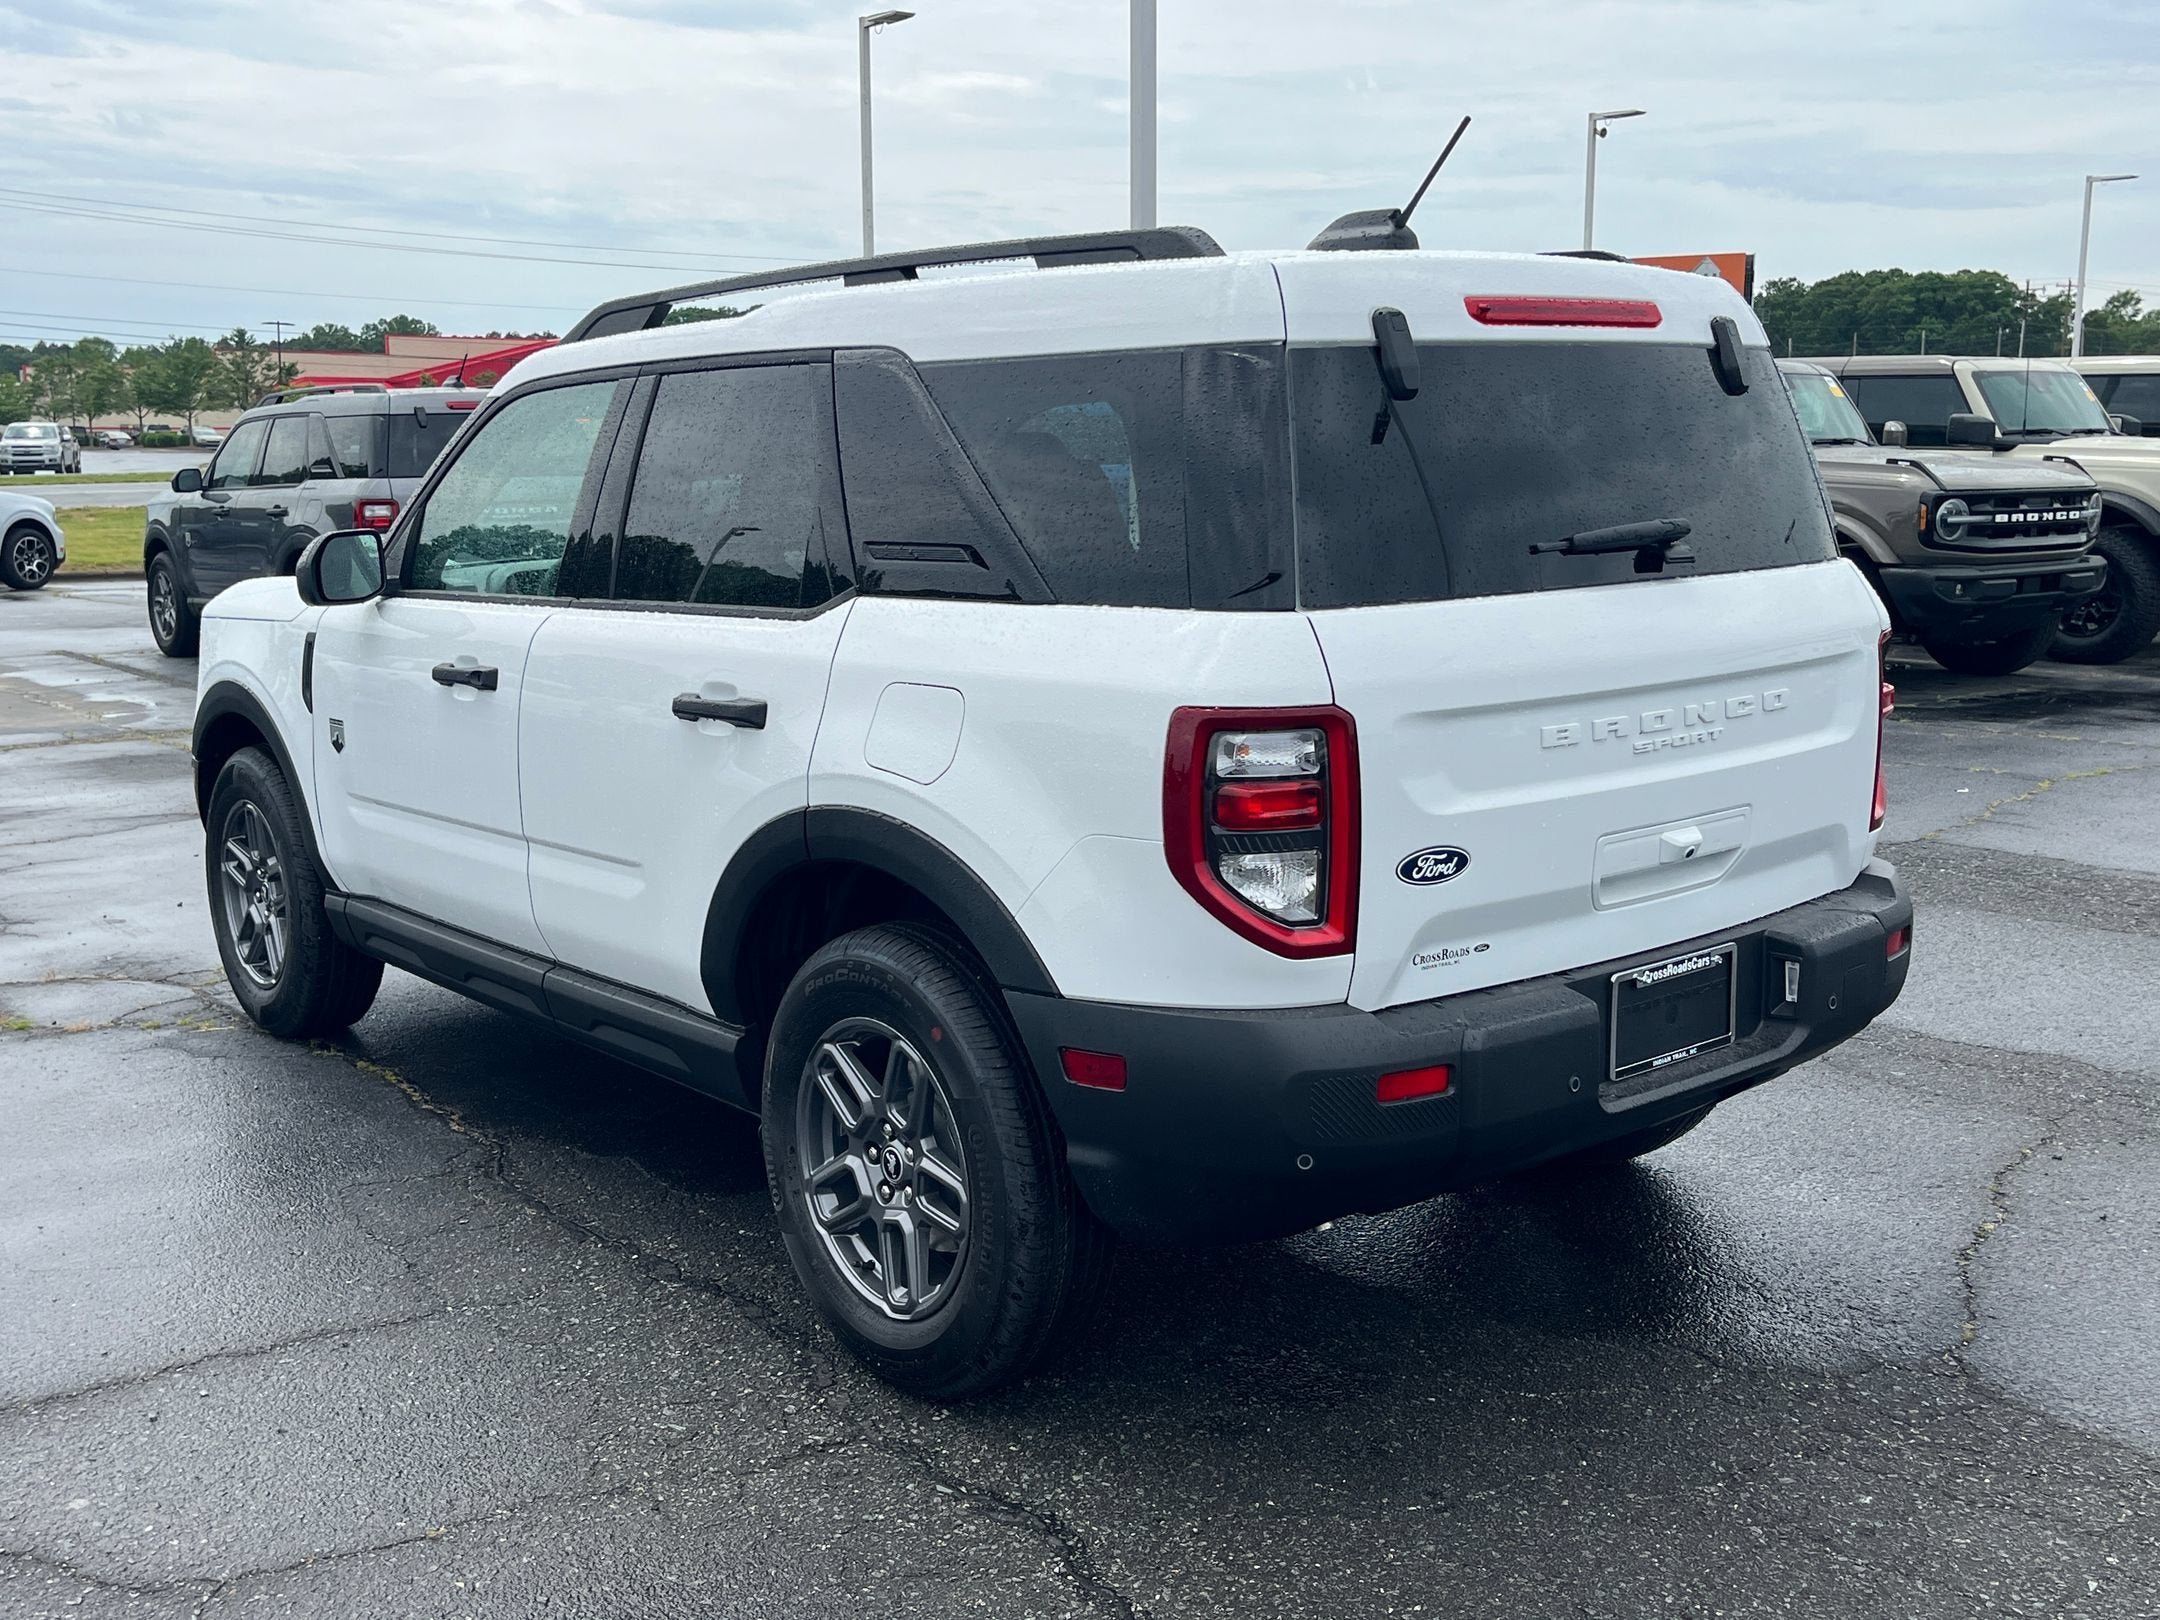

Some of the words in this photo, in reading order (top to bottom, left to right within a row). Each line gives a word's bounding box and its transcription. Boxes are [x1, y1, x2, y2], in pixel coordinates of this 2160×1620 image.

[1994, 510, 2081, 523] BRONCO
[1540, 688, 1790, 749] BRONCO
[1633, 726, 1725, 754] SPORT
[1412, 853, 1459, 880] Ford
[1643, 956, 1710, 984] CrossRoadsCars
[1652, 1055, 1672, 1067] INDIAN
